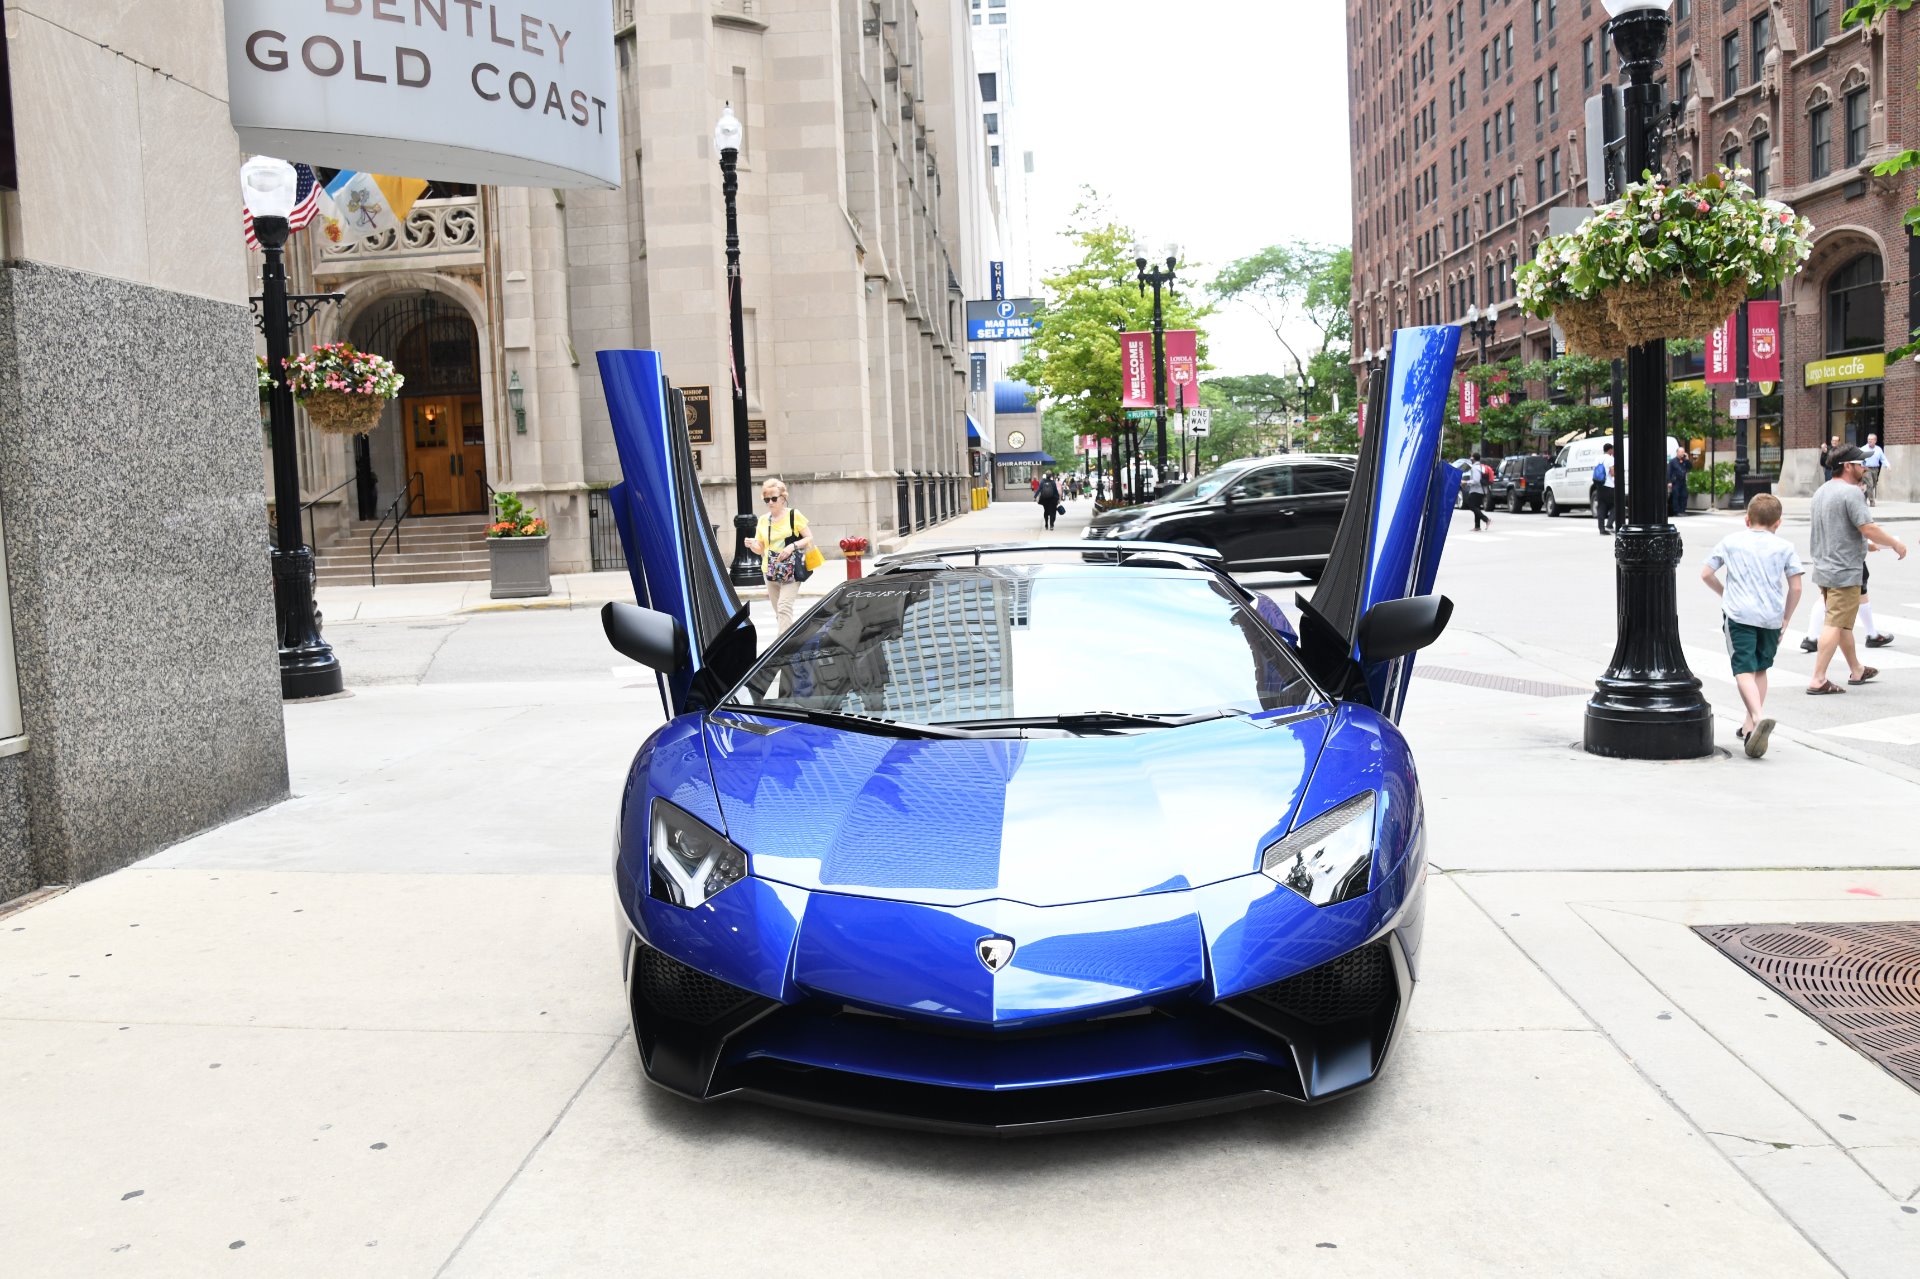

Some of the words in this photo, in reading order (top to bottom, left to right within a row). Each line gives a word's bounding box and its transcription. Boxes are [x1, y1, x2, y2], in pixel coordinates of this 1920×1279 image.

[245, 29, 432, 89] GOLD
[471, 62, 607, 134] COAST
[1001, 303, 1012, 316] P
[977, 328, 1004, 338] SELF
[984, 319, 1005, 328] MAG
[1007, 318, 1029, 327] MILE
[1713, 326, 1722, 374] WELCO
[1129, 341, 1141, 399] WELCOME
[1824, 366, 1836, 377] tea
[1838, 357, 1865, 376] café
